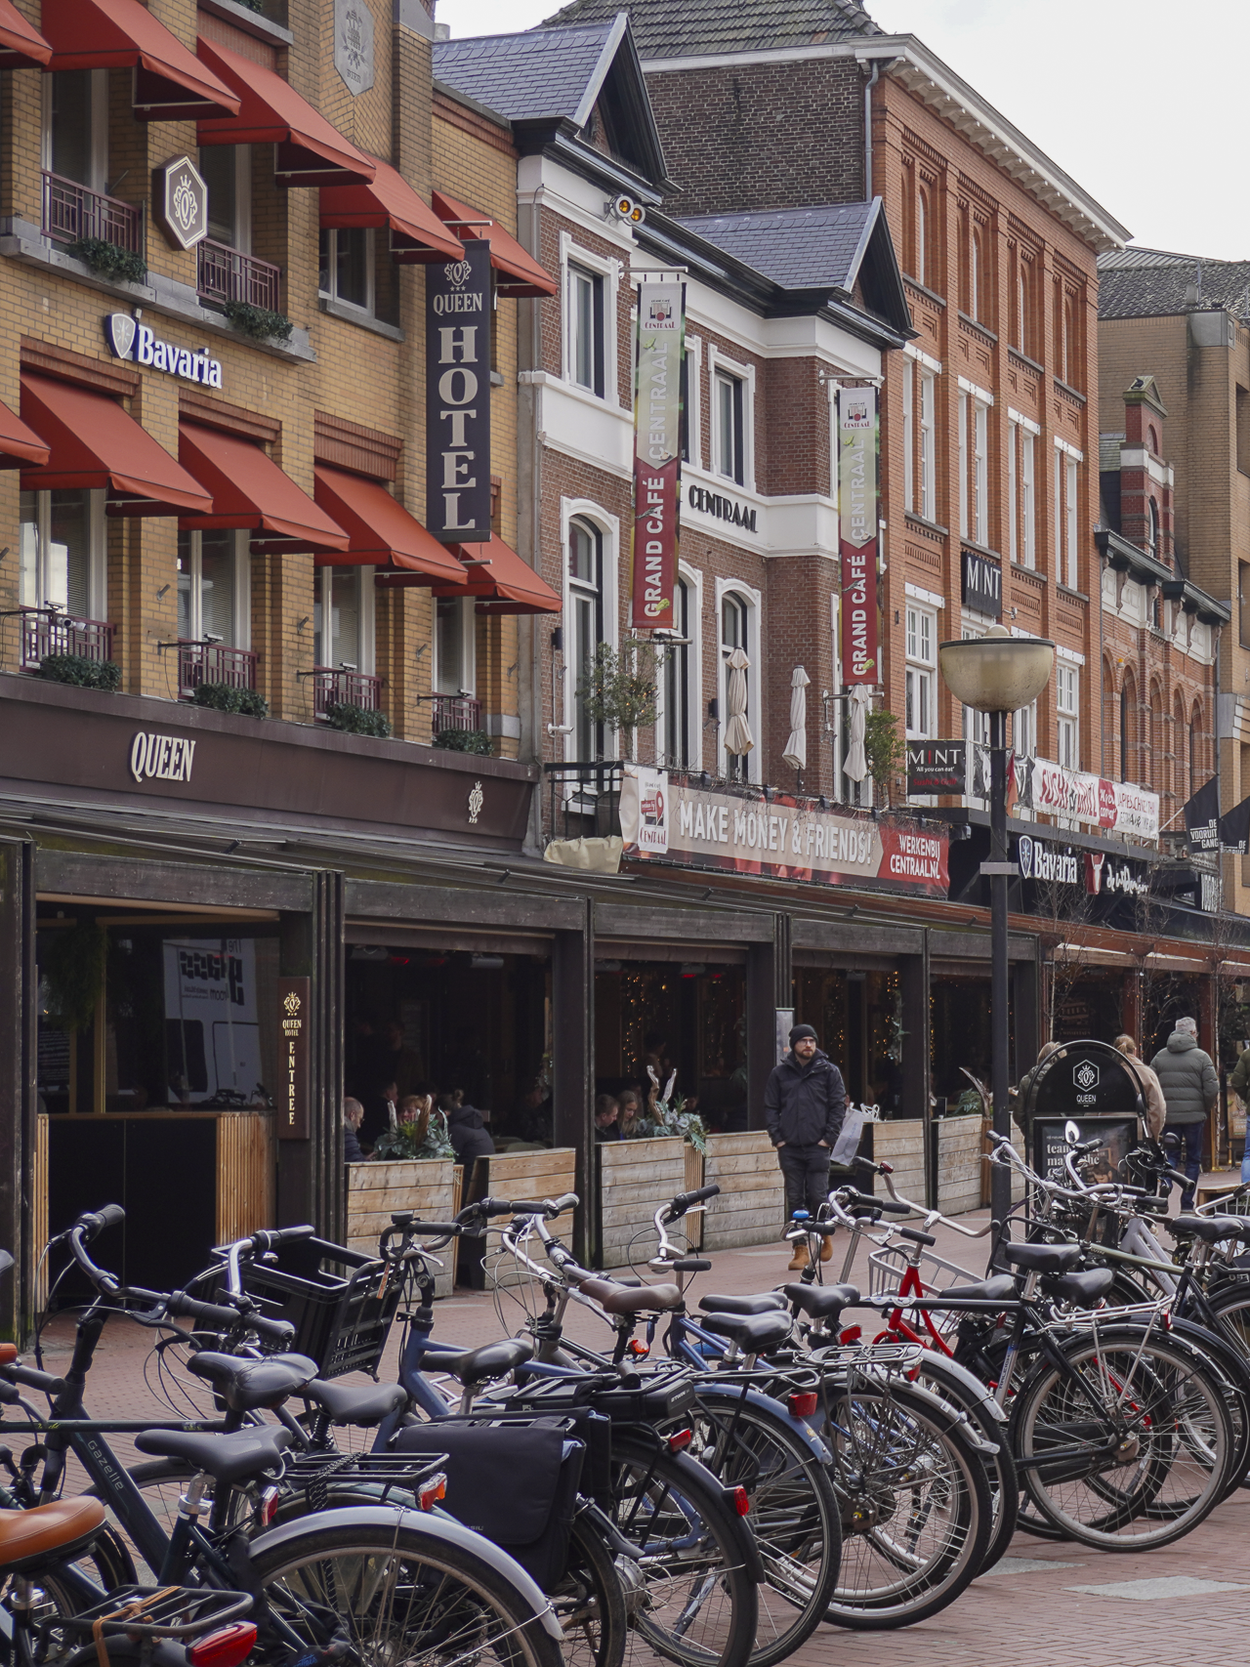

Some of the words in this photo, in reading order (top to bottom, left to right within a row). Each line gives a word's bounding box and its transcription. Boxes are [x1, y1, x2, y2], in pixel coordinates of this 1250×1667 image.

[433, 292, 483, 316] QUEEN
[138, 323, 223, 389] Bavaria
[648, 342, 669, 461] CENTRAAL
[437, 325, 479, 531] HOTEL
[642, 477, 664, 534] CAFÉ
[689, 485, 759, 534] CENTRAAL
[851, 438, 865, 541] CENTRAAL
[644, 540, 662, 617] GRAND
[847, 555, 866, 604] CAFÉ
[967, 556, 1001, 600] MINT
[852, 607, 867, 676] GRAND
[131, 731, 197, 783] QUEEN
[908, 749, 961, 765] MINT
[680, 800, 729, 843] MAKE
[733, 808, 788, 852] MONEY
[791, 820, 802, 855] &
[805, 821, 873, 865] FRIENDS!
[1190, 828, 1217, 840] VOORUIT
[1201, 839, 1219, 849] GANG
[1208, 819, 1217, 829] DE
[1238, 840, 1246, 849] DE
[1034, 841, 1077, 884] Bavaria
[282, 1019, 302, 1029] QUEEN
[288, 1041, 296, 1126] ENTREE
[1076, 1094, 1097, 1103] QUEEN
[87, 1440, 124, 1491] Gazelle
